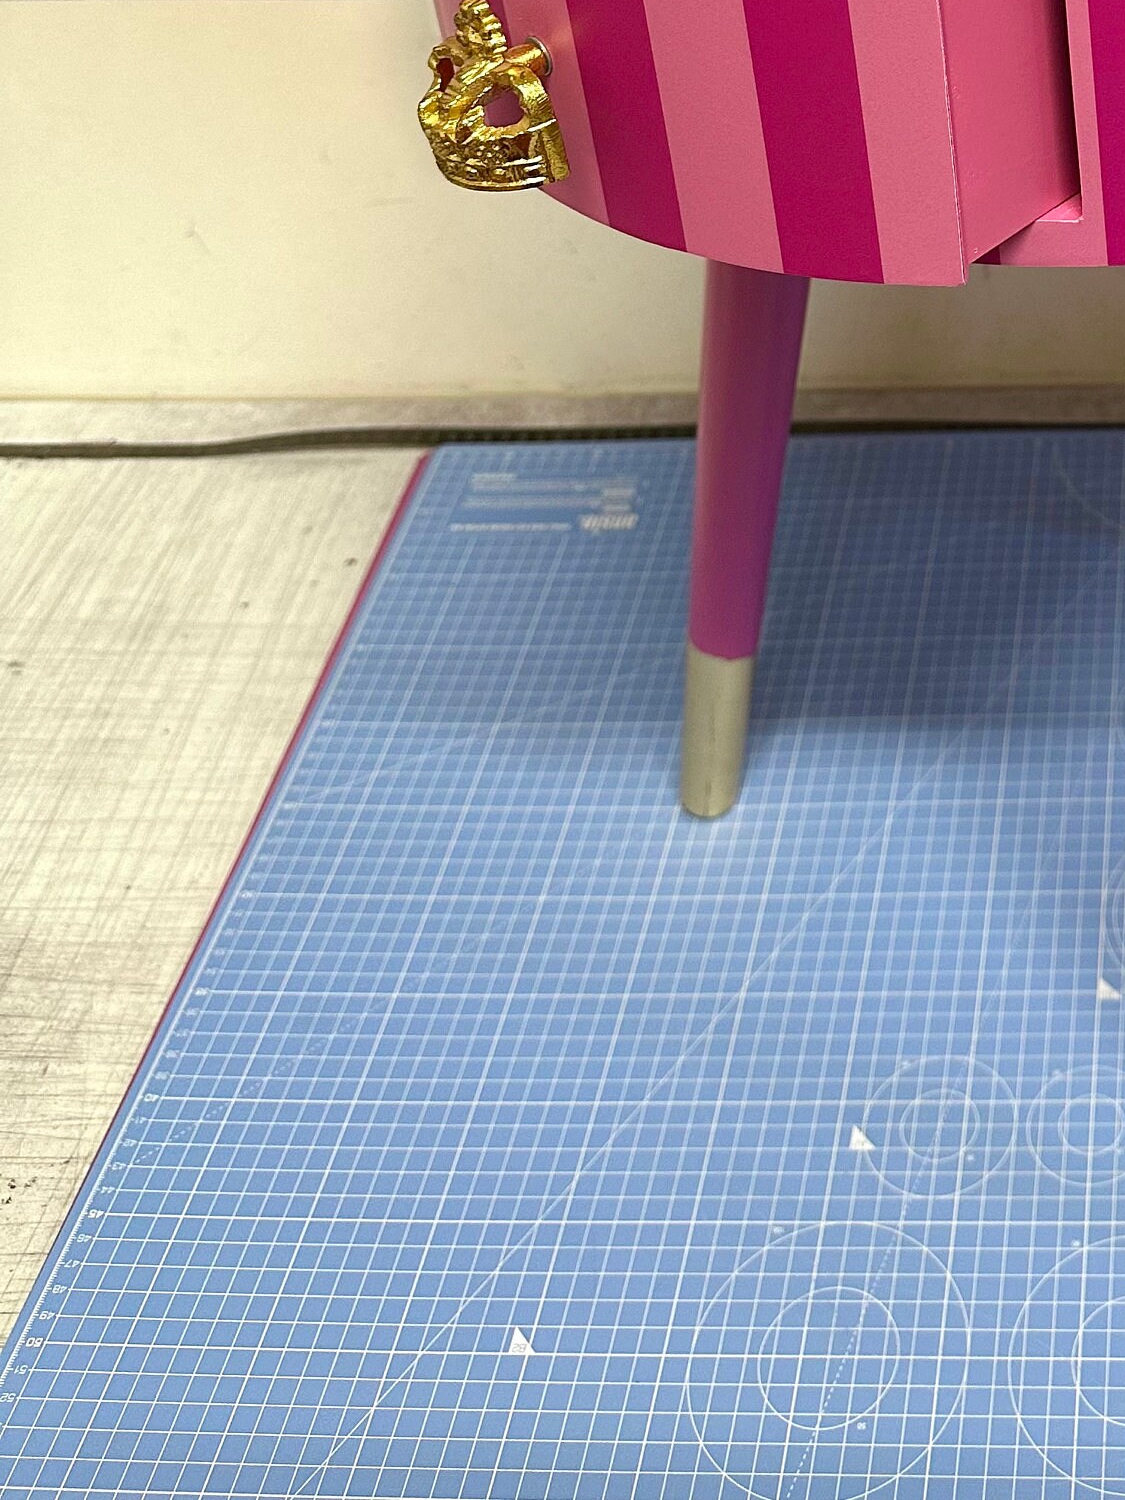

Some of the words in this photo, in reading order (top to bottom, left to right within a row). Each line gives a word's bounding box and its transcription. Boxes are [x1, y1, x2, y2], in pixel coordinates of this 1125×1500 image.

[88, 1209, 104, 1218] 45
[76, 1234, 92, 1243] 46
[64, 1259, 80, 1268] 47
[52, 1284, 67, 1294] 48
[39, 1311, 55, 1320] 49
[25, 1337, 43, 1347] 50
[14, 1365, 28, 1375] 51
[0, 1393, 16, 1402] 52
